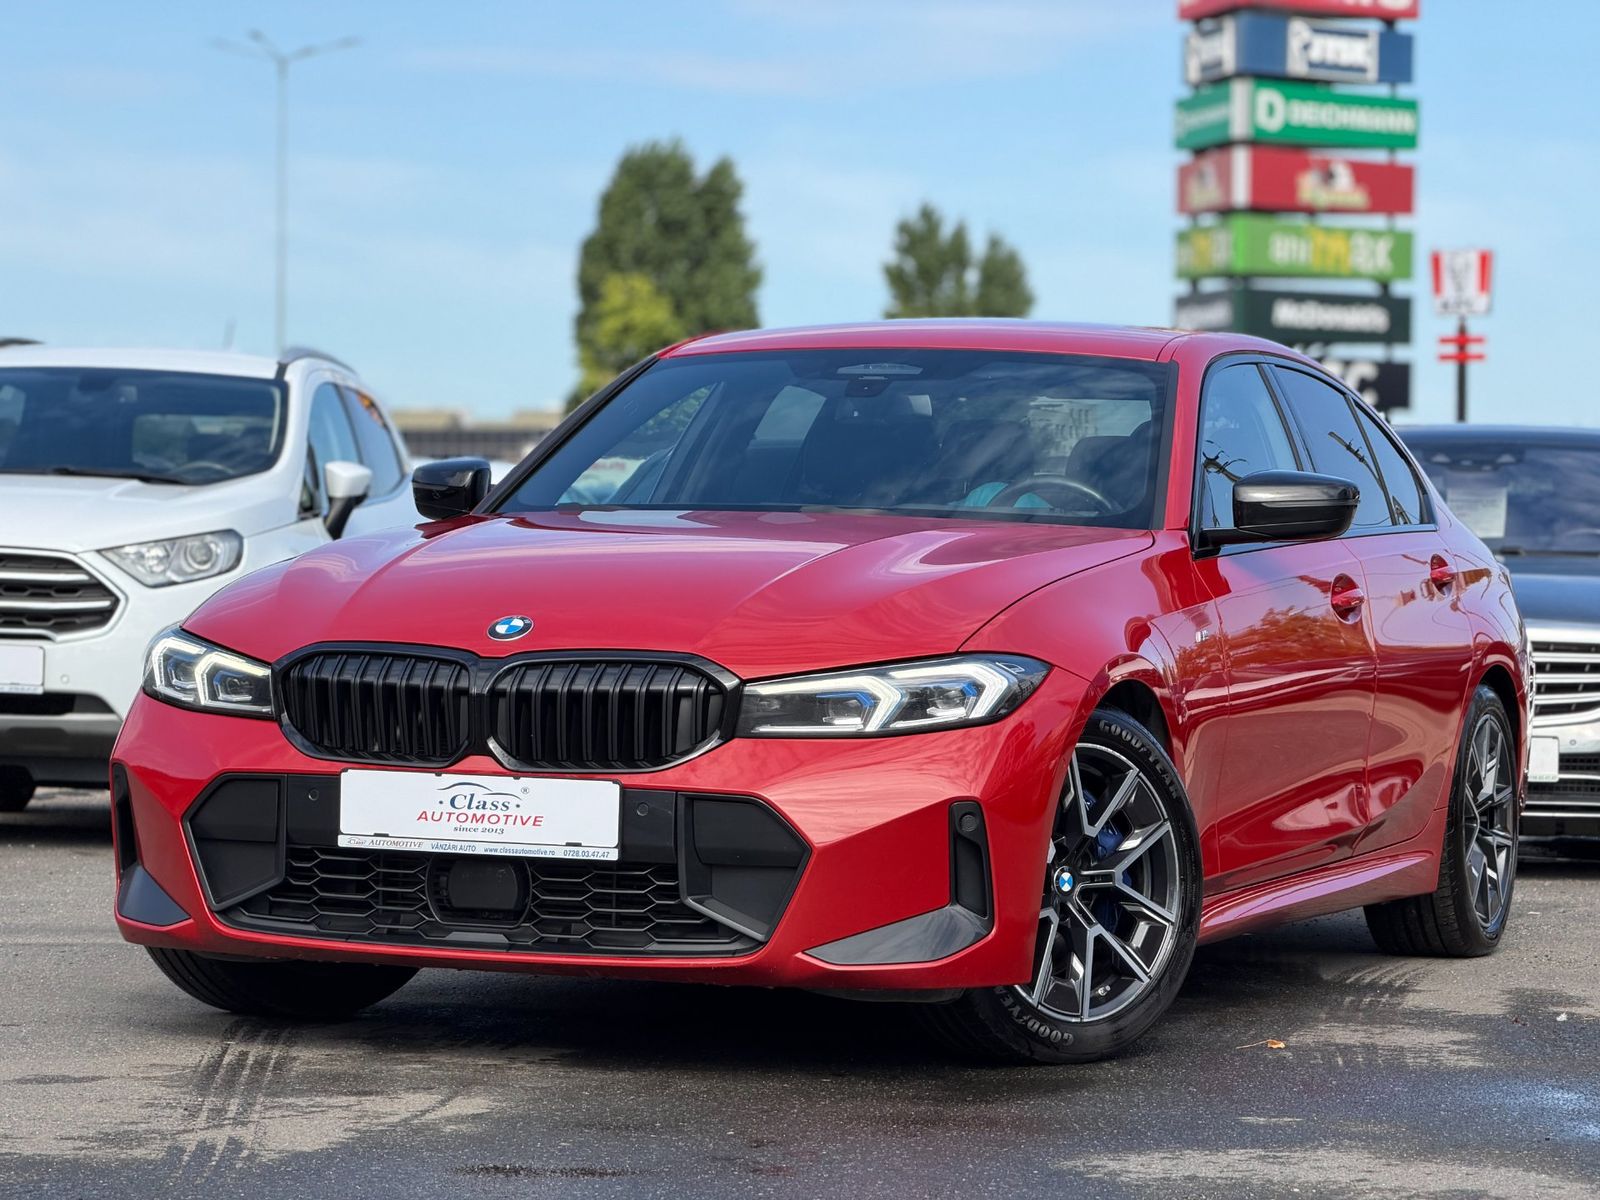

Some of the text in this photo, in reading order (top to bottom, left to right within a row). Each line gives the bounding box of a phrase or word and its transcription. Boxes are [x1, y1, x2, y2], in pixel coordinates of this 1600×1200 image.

[449, 793, 511, 811] Class
[416, 811, 544, 827] AUTOMOTIVE
[453, 825, 479, 833] since
[368, 839, 424, 849] AUTOMOTIVE
[458, 844, 477, 853] AUTO
[483, 846, 556, 856] www.classautomotive.ro
[563, 849, 610, 859] 0728.03.47.47
